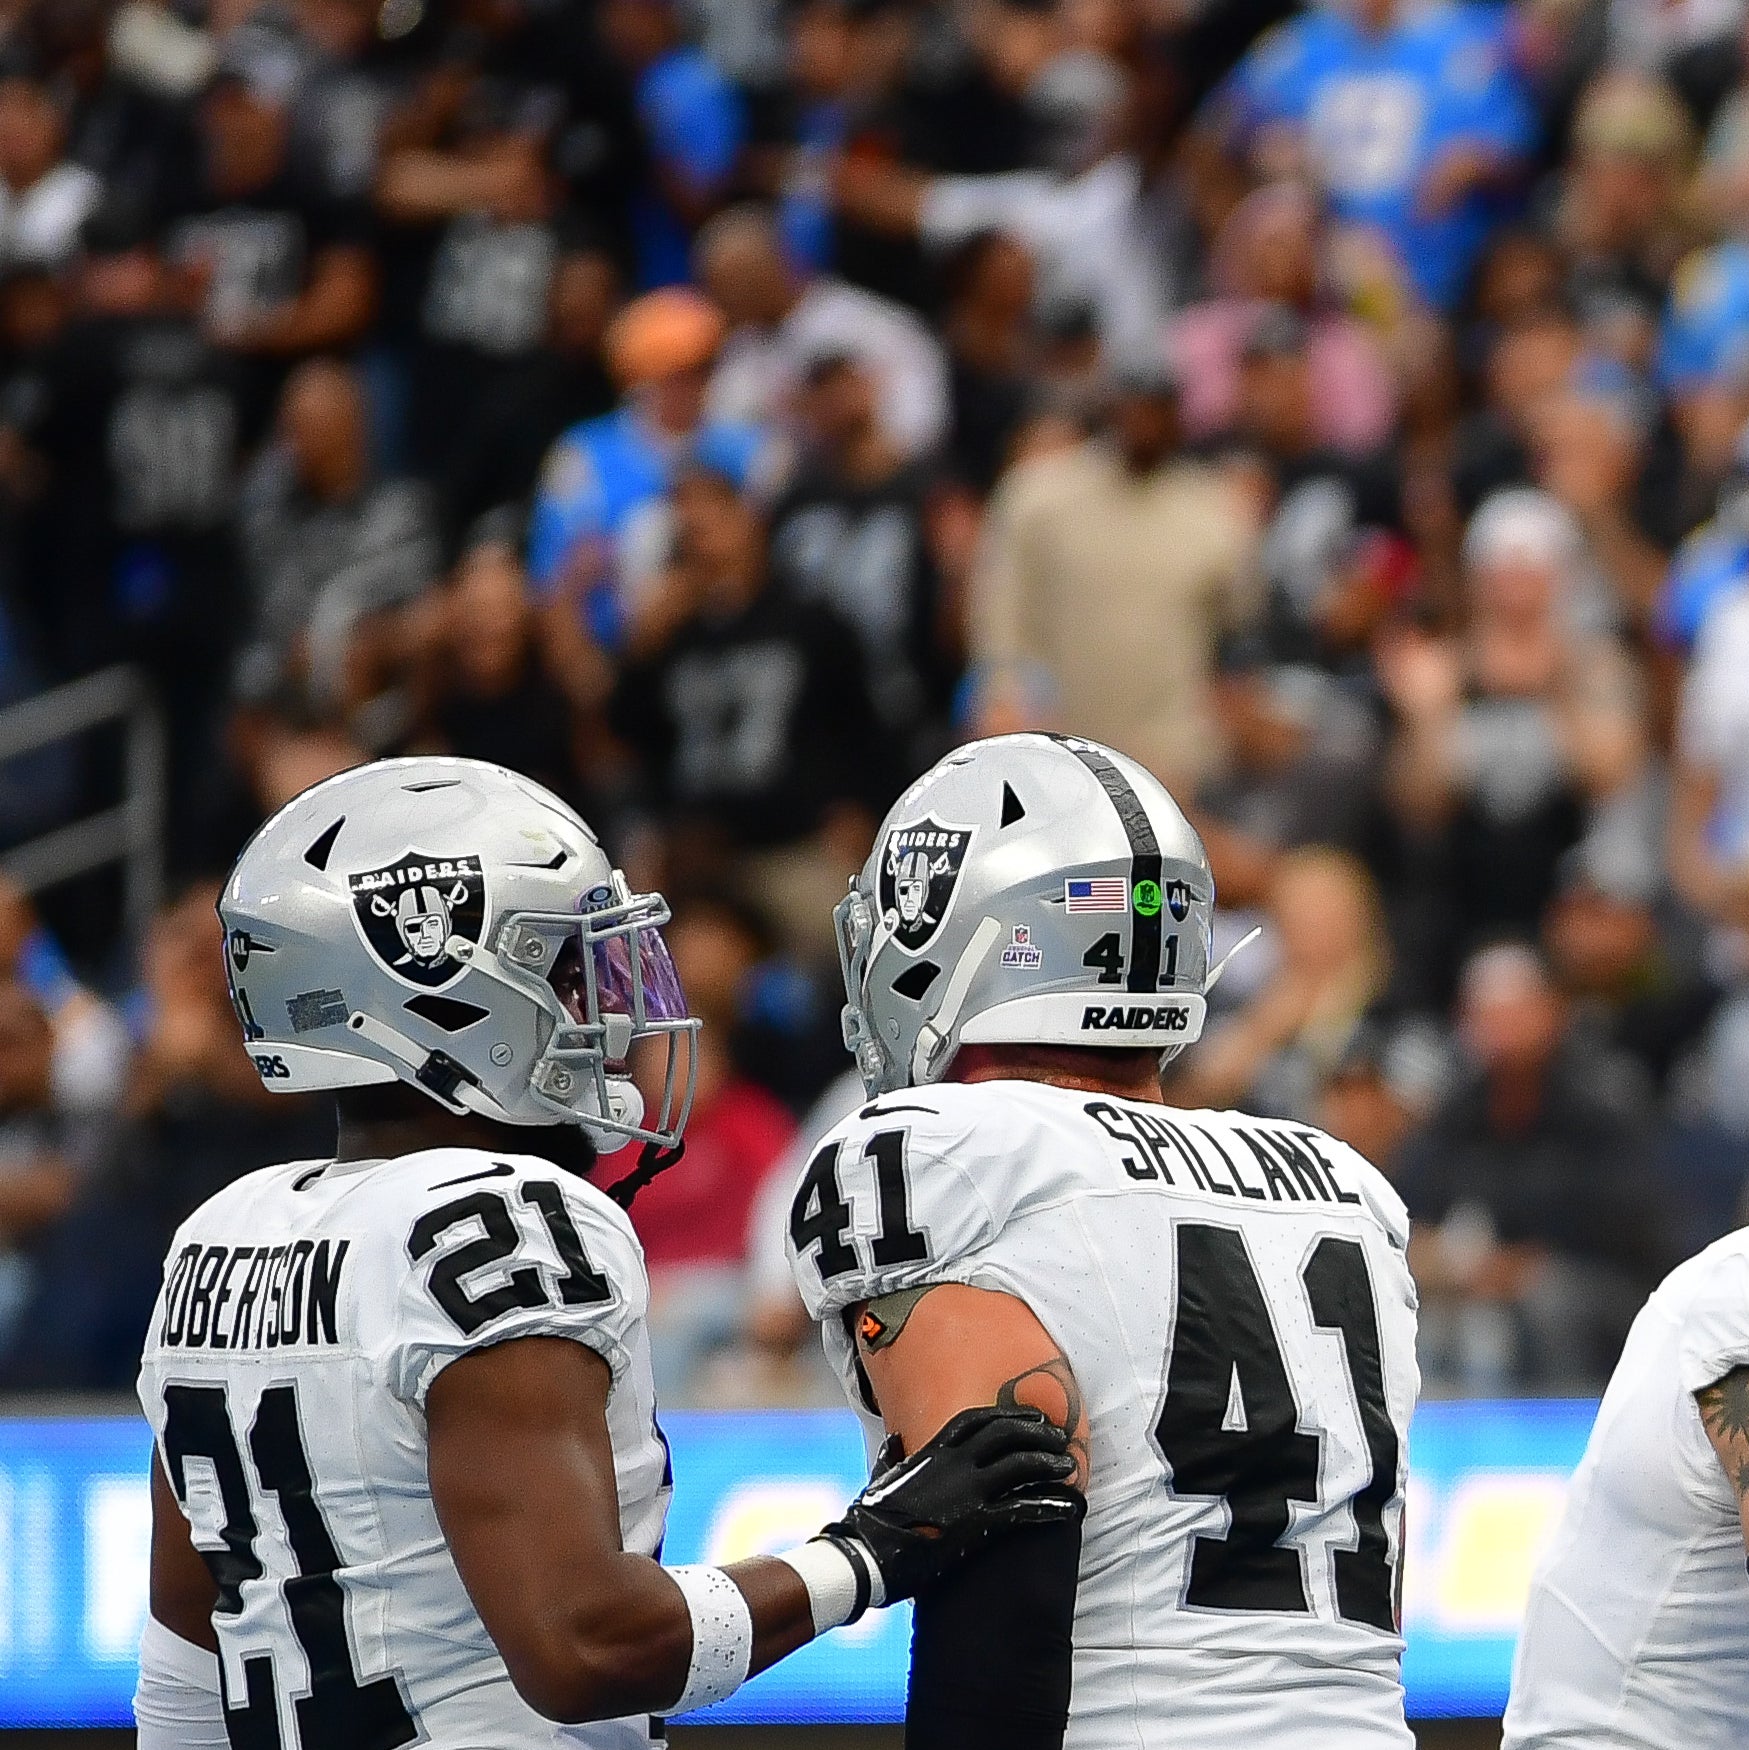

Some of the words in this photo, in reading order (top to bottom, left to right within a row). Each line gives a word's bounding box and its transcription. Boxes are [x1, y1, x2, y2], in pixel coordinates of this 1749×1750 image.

[361, 859, 472, 889] RAIDERS
[889, 831, 962, 851] RAIDERS
[1171, 888, 1189, 907] AL
[1081, 1006, 1190, 1030] RAIDERS
[1083, 1101, 1362, 1207] SPILLANE
[789, 1129, 932, 1281] 41
[407, 1181, 614, 1337] 21
[1155, 1223, 1400, 1634] 41
